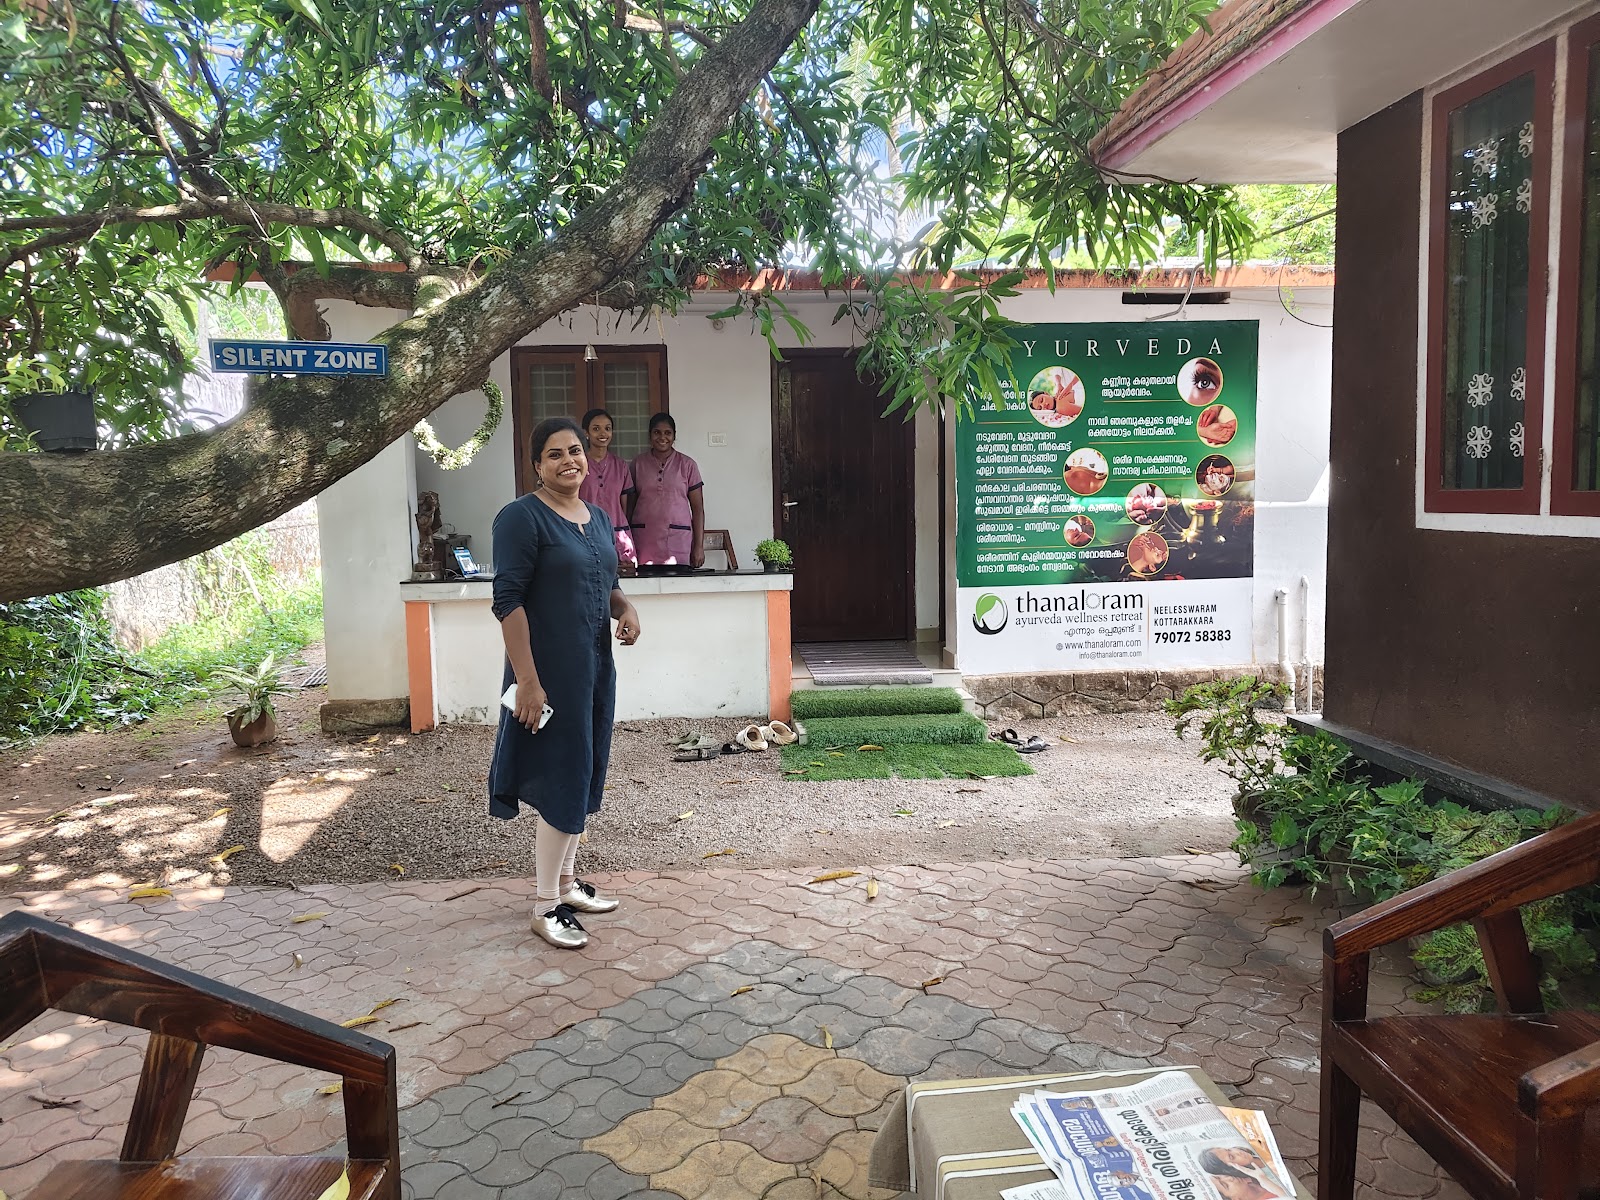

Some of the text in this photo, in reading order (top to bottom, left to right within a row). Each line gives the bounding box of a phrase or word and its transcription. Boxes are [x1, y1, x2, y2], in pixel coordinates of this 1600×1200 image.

[1022, 337, 1223, 357] YURVEDA
[222, 347, 378, 370] SILENT ZONE
[1101, 374, 1177, 387] കണ്ണിനു കരുതലായി
[1101, 388, 1153, 398] ആയുർവേദം.
[1088, 416, 1109, 426] നാഡി
[1017, 431, 1057, 442] മുട്ടുവേദന
[1020, 452, 1058, 465] തുടങ്ങിയ
[976, 466, 995, 476] എല്ലാ
[975, 482, 1062, 493] ഗർഭകാല പരിചരണവും
[975, 504, 1014, 517] സുഖമായി
[976, 522, 1014, 533] ശിരോധാര
[976, 564, 1005, 574] നേടാൻ
[1016, 589, 1144, 613] thanaloram
[1154, 604, 1217, 615] NEELESSWARAM
[1015, 611, 1143, 628] ayurveda wellness retreat
[1154, 616, 1214, 627] KOTTARAKKARA
[1064, 627, 1096, 637] എന്നും
[1154, 629, 1231, 644] 79072 58383
[1065, 639, 1142, 650] www.thanaloram.com
[1079, 650, 1142, 660] info@thanaloram.com
